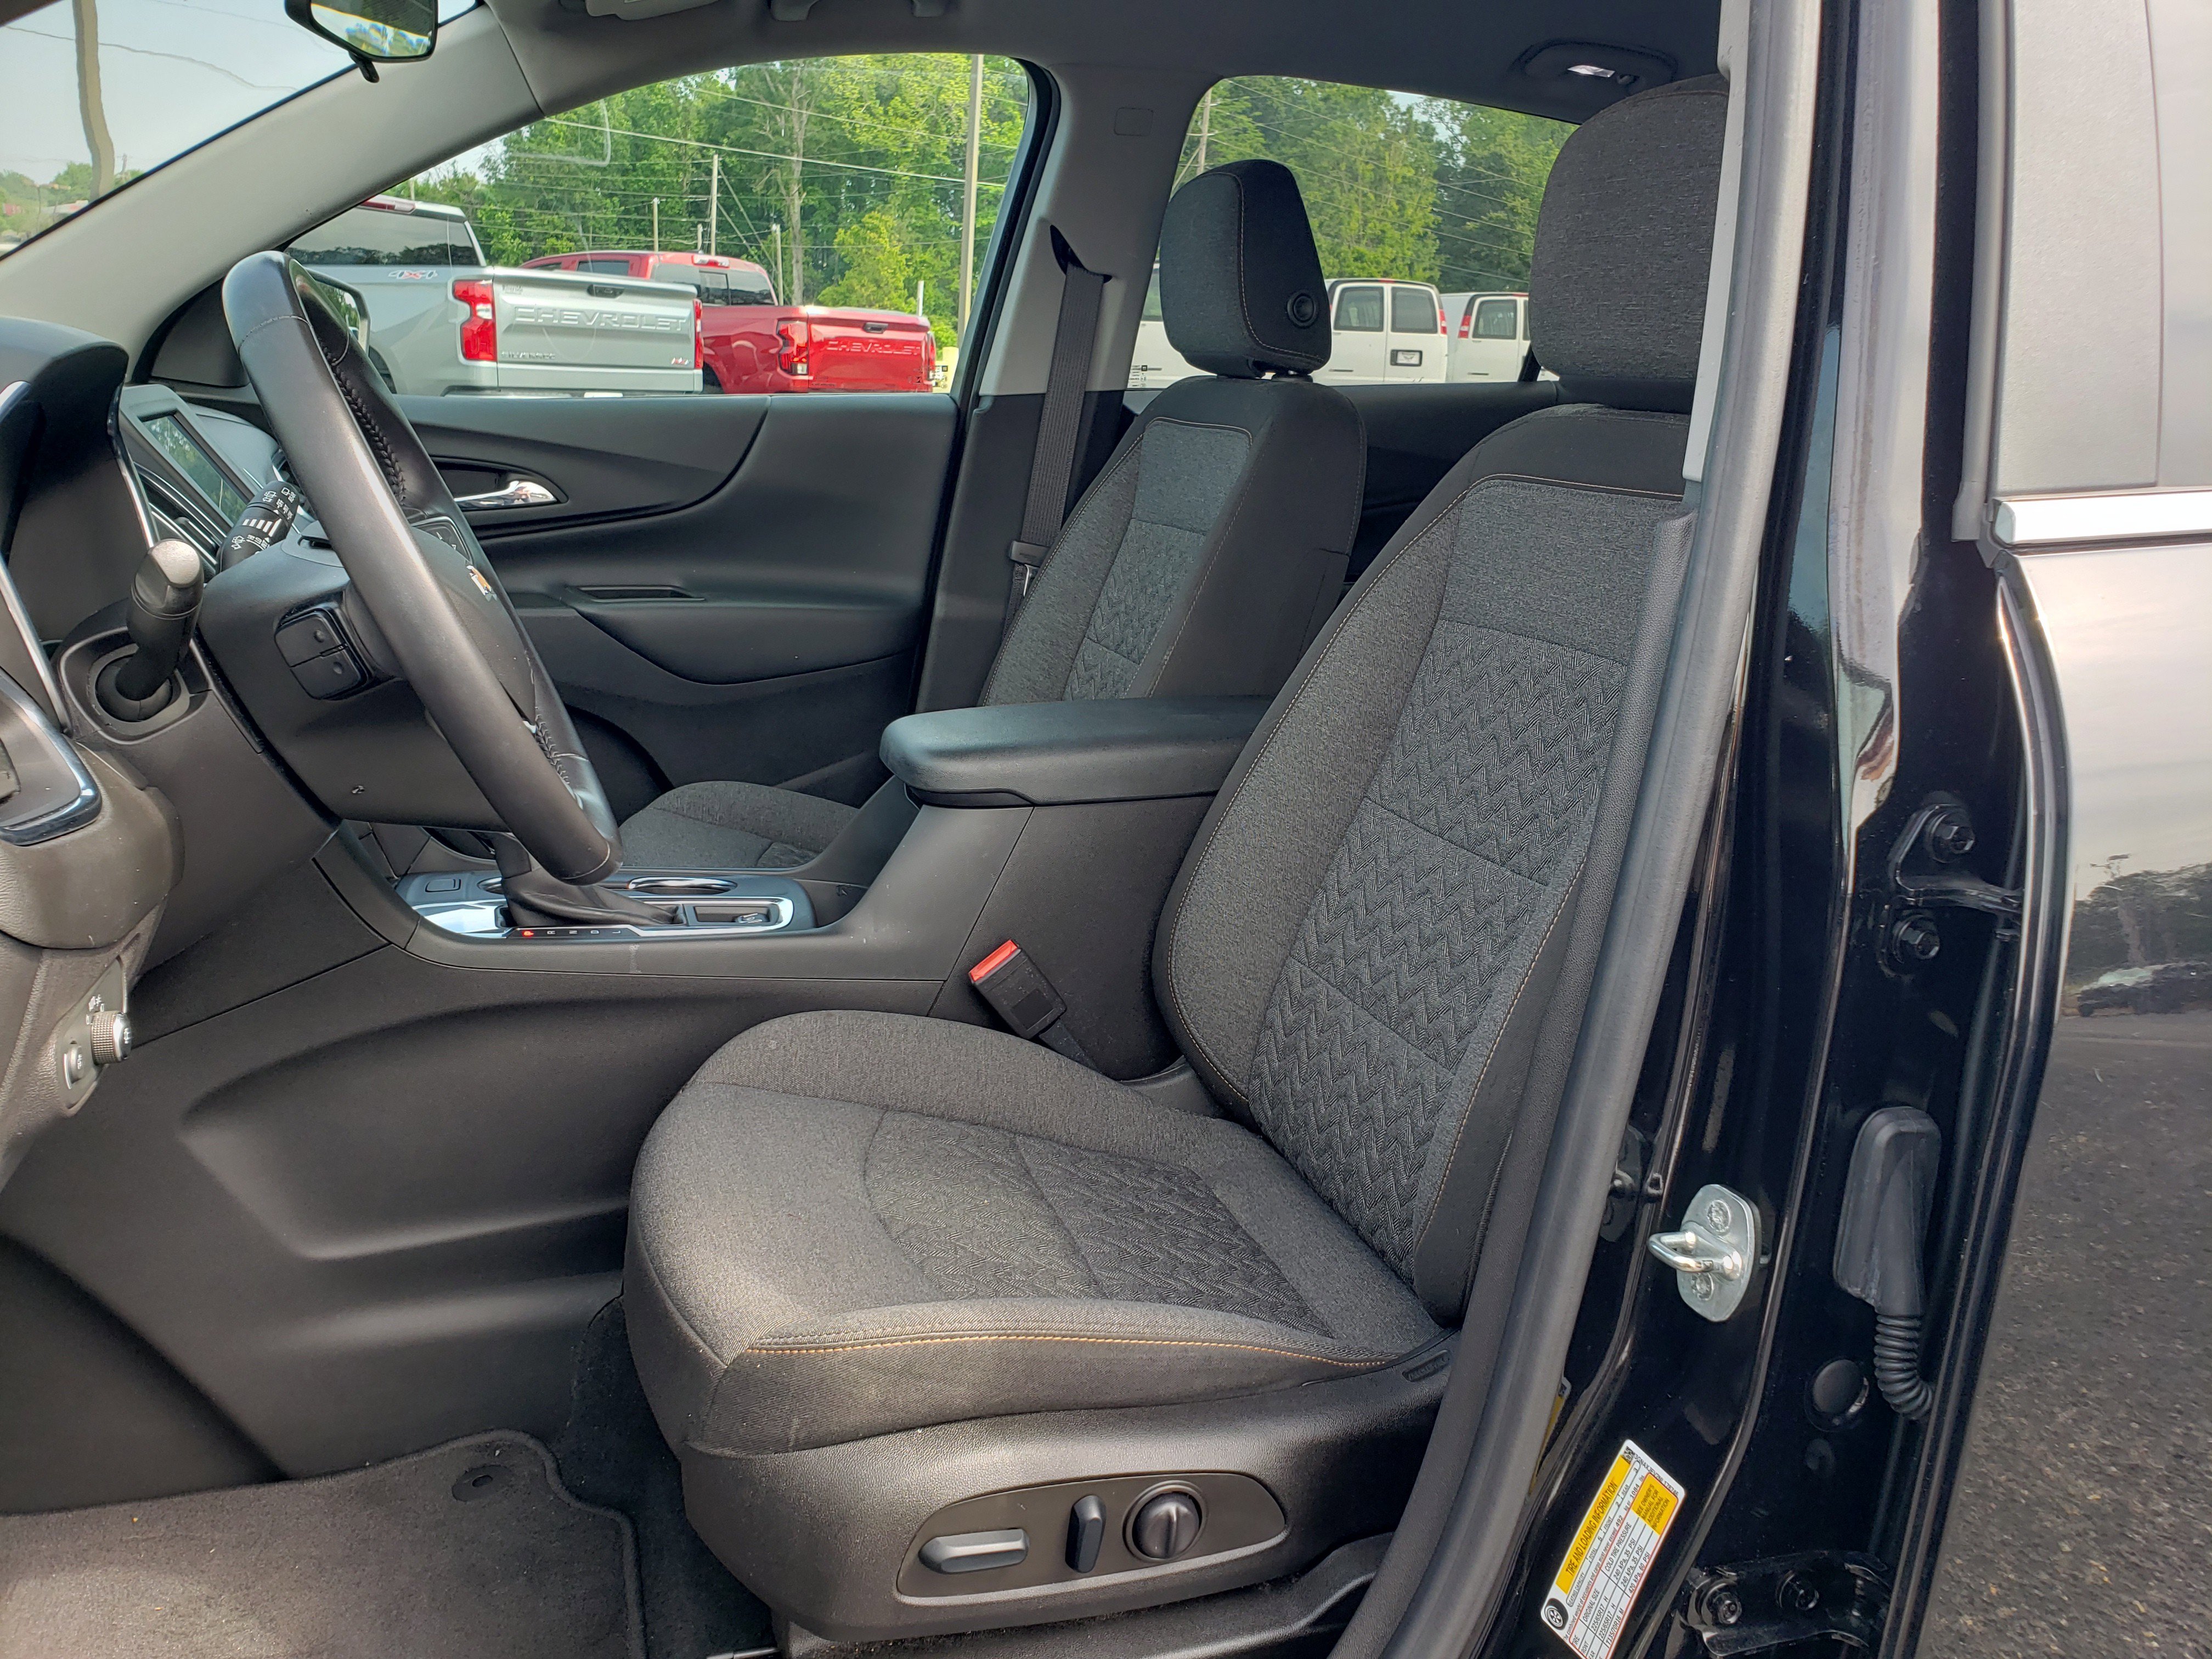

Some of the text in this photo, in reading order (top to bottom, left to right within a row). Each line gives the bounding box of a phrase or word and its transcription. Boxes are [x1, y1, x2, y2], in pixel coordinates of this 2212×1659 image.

[515, 307, 686, 331] CHEVROLET
[1629, 1483, 1639, 1499] 1084
[1651, 1488, 1659, 1500] FOR
[1603, 1516, 1612, 1530] FRONT
[1647, 1496, 1663, 1523] ADDITIONAL
[1566, 1480, 1617, 1576] TIRE AND LOADING INFORMATION
[1604, 1521, 1632, 1572] COLD TIRE PRESSURE
[1631, 1555, 1638, 1564] 35
[1613, 1568, 1621, 1580] 240
[1623, 1548, 1630, 1557] 35
[1638, 1562, 1645, 1571] 60
[1567, 1571, 1584, 1606] SEATING CAPACITY
[1582, 1588, 1600, 1622] ORIGINAL SIZE
[1591, 1603, 1605, 1631] 225/65R17
[1598, 1610, 1613, 1639] 225/65R17
[1606, 1615, 1621, 1645] T135/70R16
